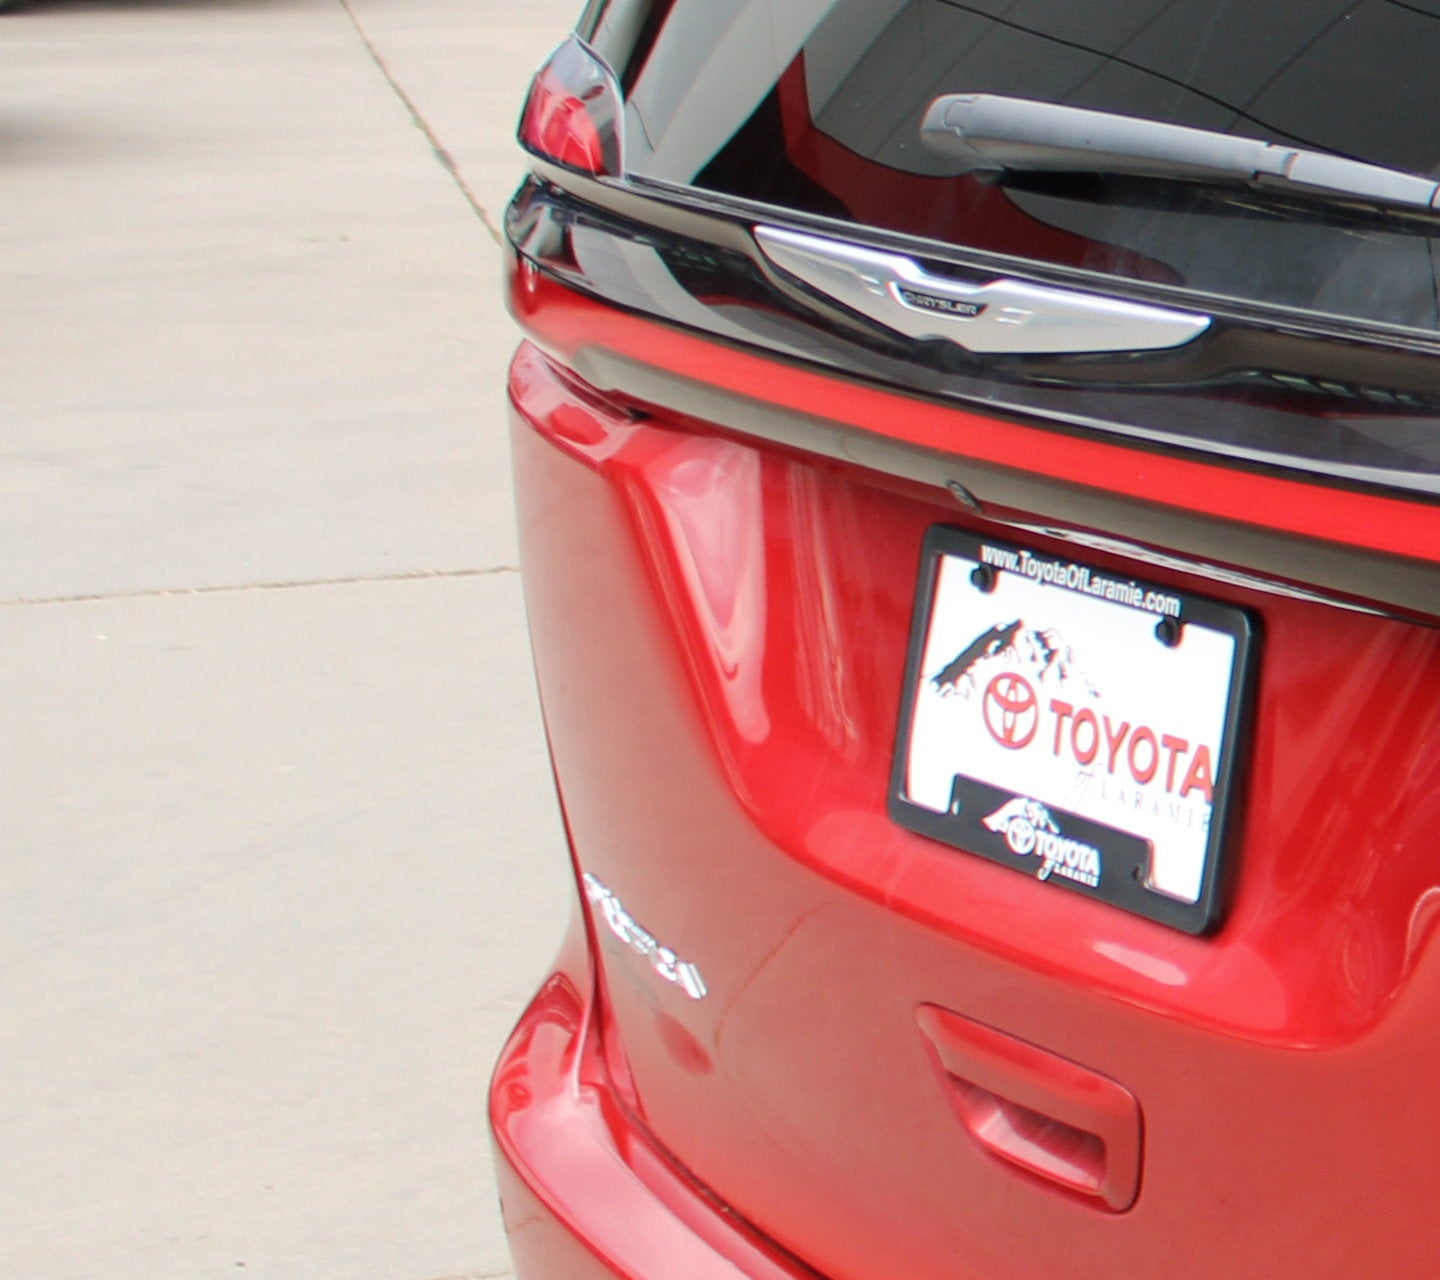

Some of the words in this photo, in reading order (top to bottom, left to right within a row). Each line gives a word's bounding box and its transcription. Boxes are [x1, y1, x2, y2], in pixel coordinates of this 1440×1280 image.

[980, 544, 1181, 618] www.ToyotaOfLaramie.com
[1050, 698, 1214, 805] TOYOTA
[1035, 829, 1100, 877] TOYOTA
